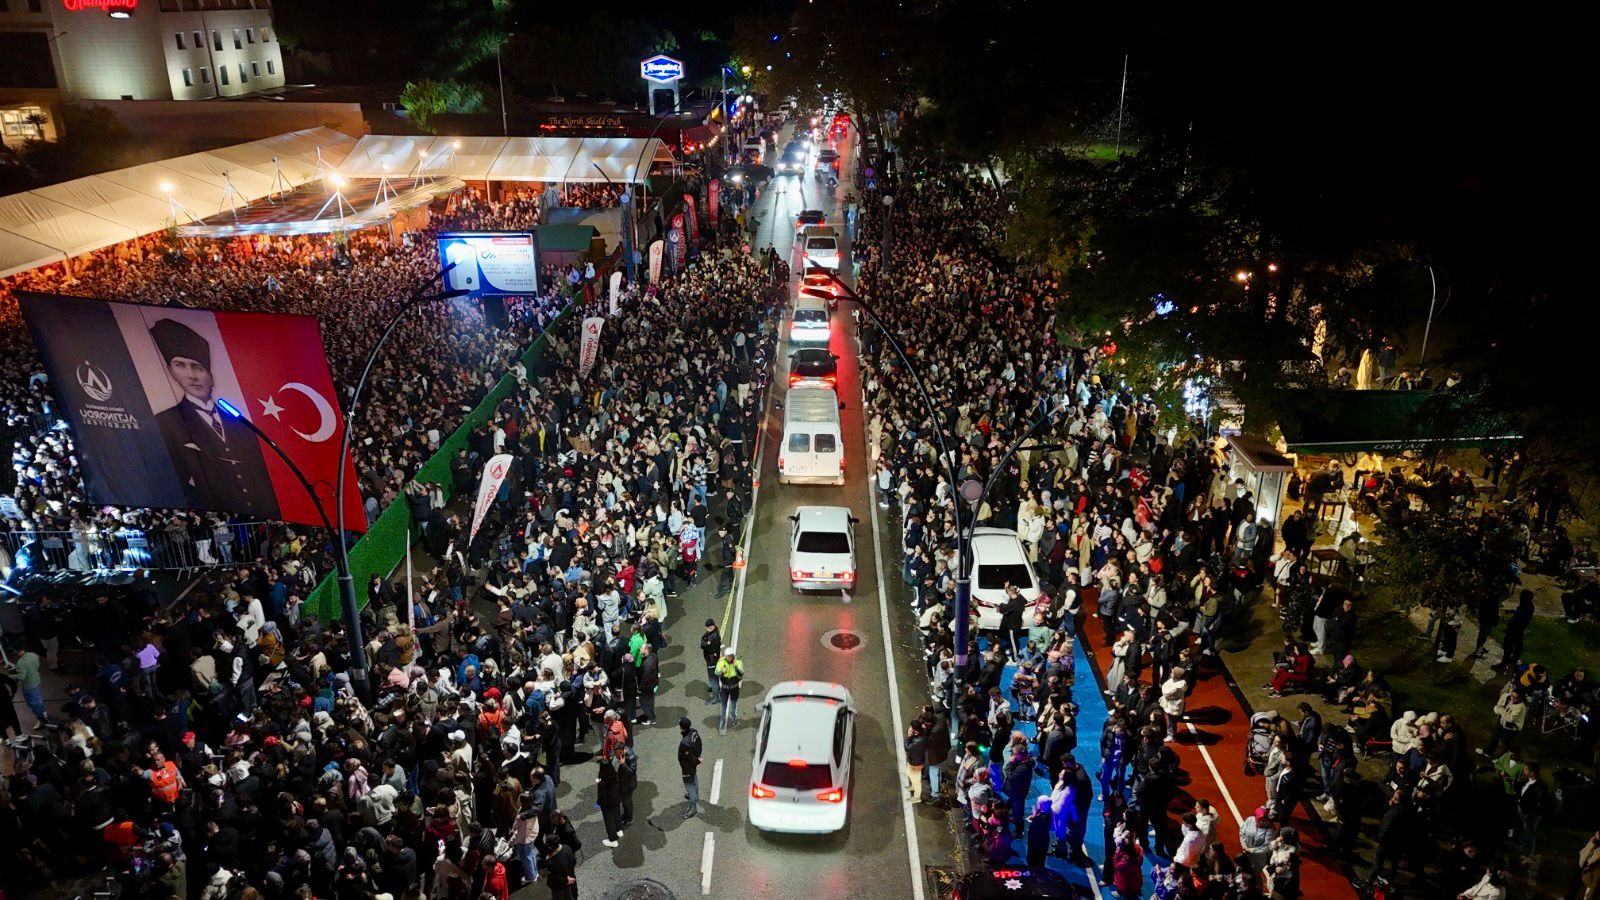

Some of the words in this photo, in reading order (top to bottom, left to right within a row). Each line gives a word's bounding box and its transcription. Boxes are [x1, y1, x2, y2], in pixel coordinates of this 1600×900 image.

[548, 116, 561, 125] The
[563, 116, 583, 127] North
[584, 116, 605, 125] Shield
[606, 116, 621, 126] Pub
